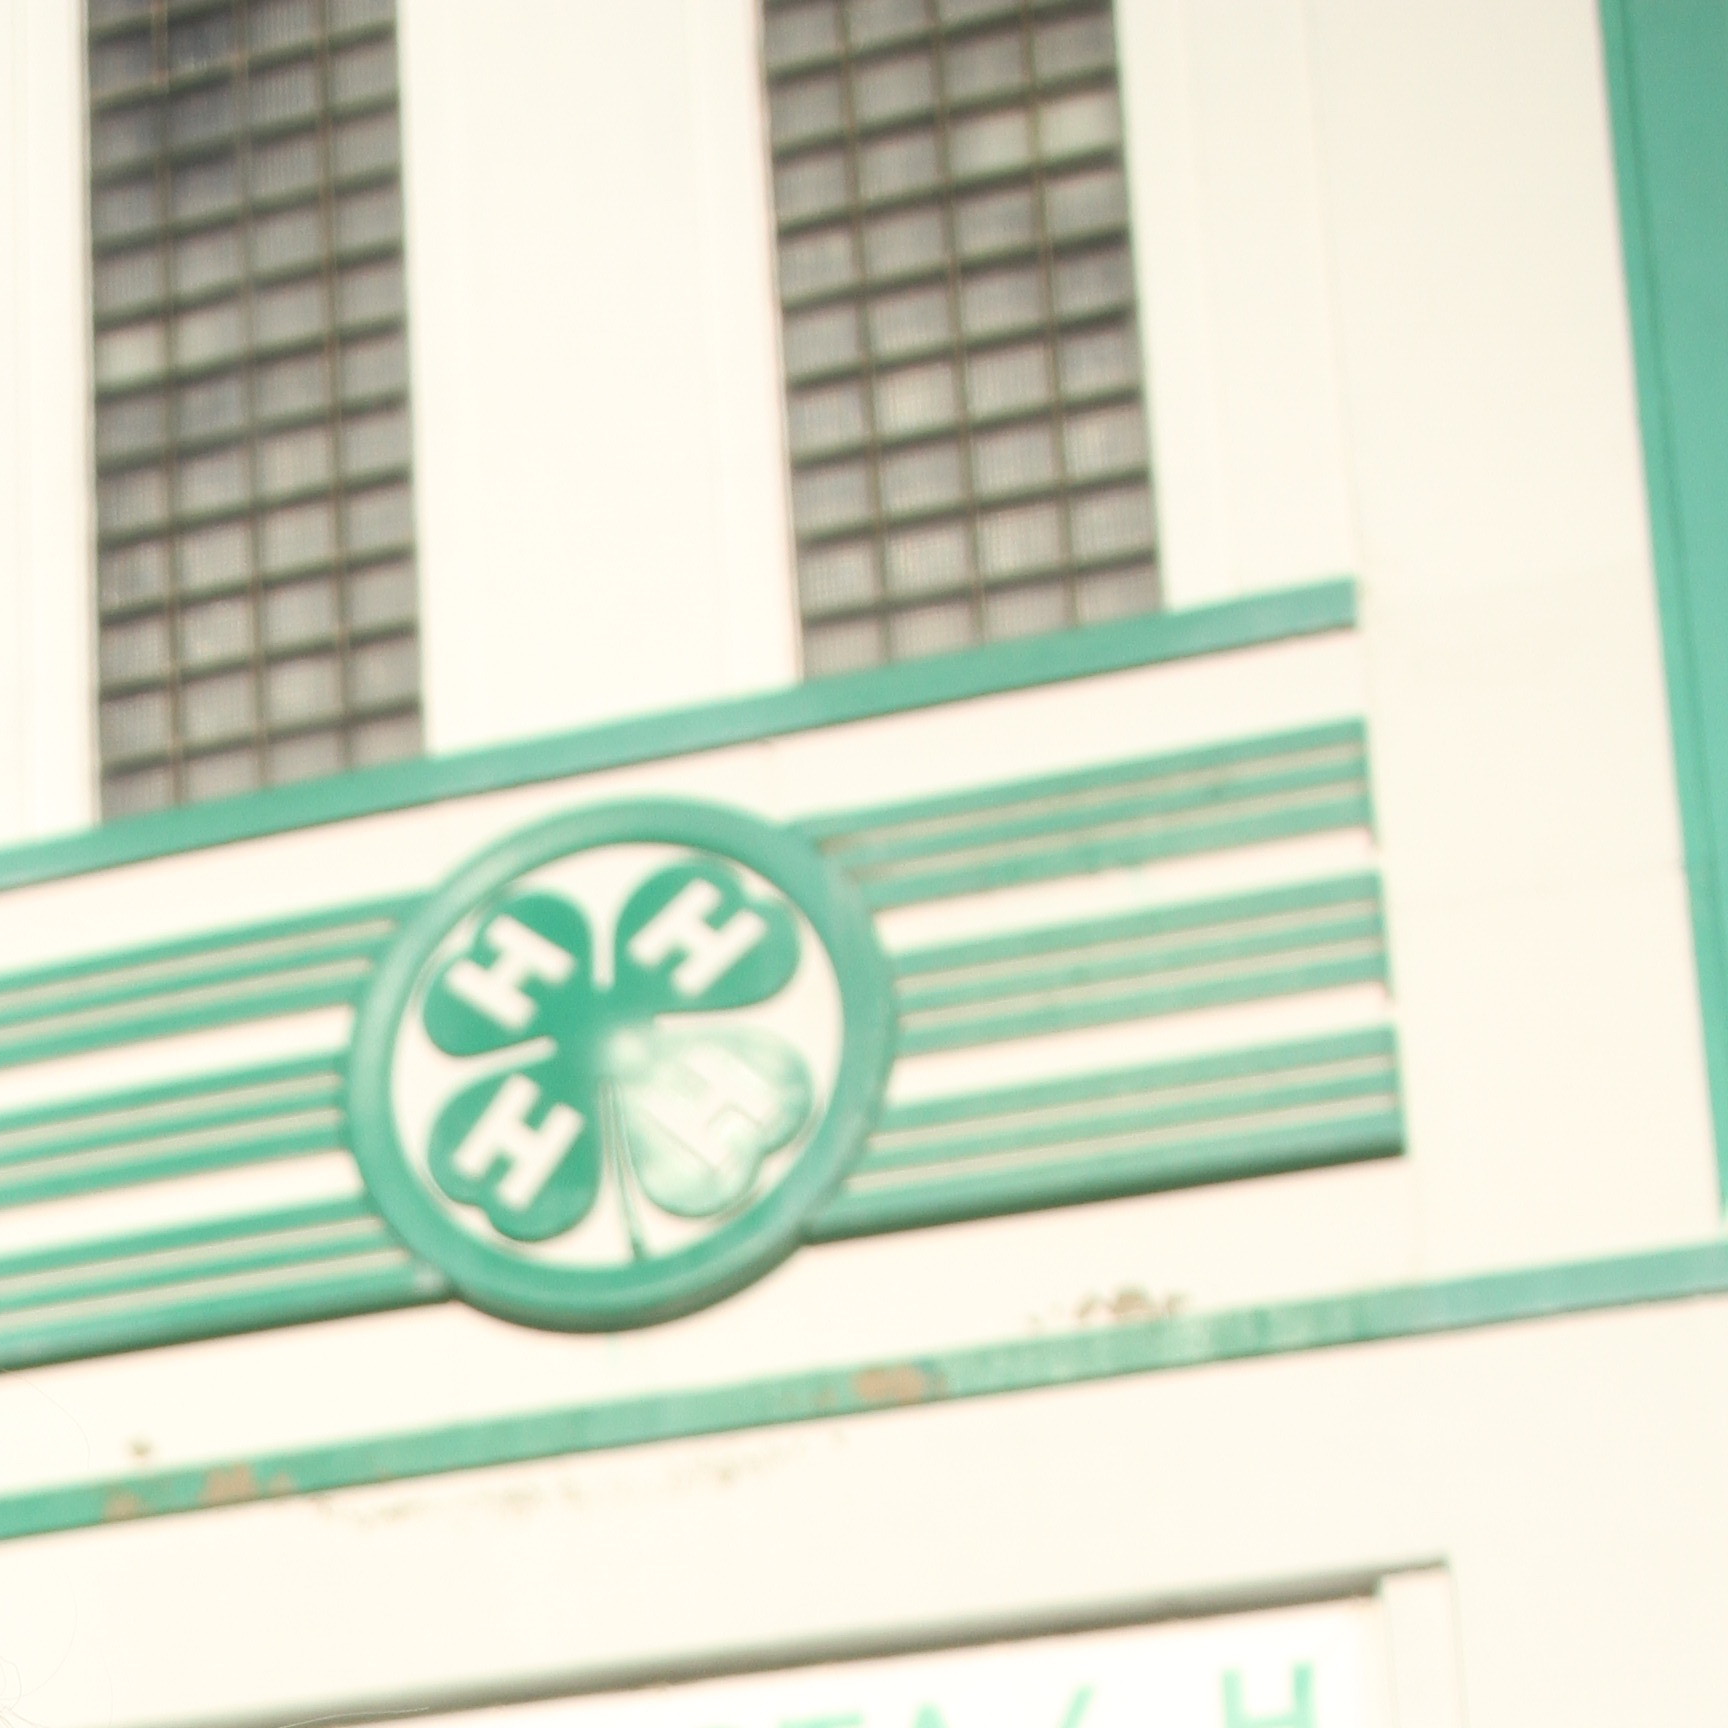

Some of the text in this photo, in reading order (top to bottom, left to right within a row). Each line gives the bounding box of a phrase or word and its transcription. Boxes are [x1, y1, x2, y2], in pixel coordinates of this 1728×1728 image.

[444, 878, 767, 1032] H H
[452, 1074, 585, 1210] H
